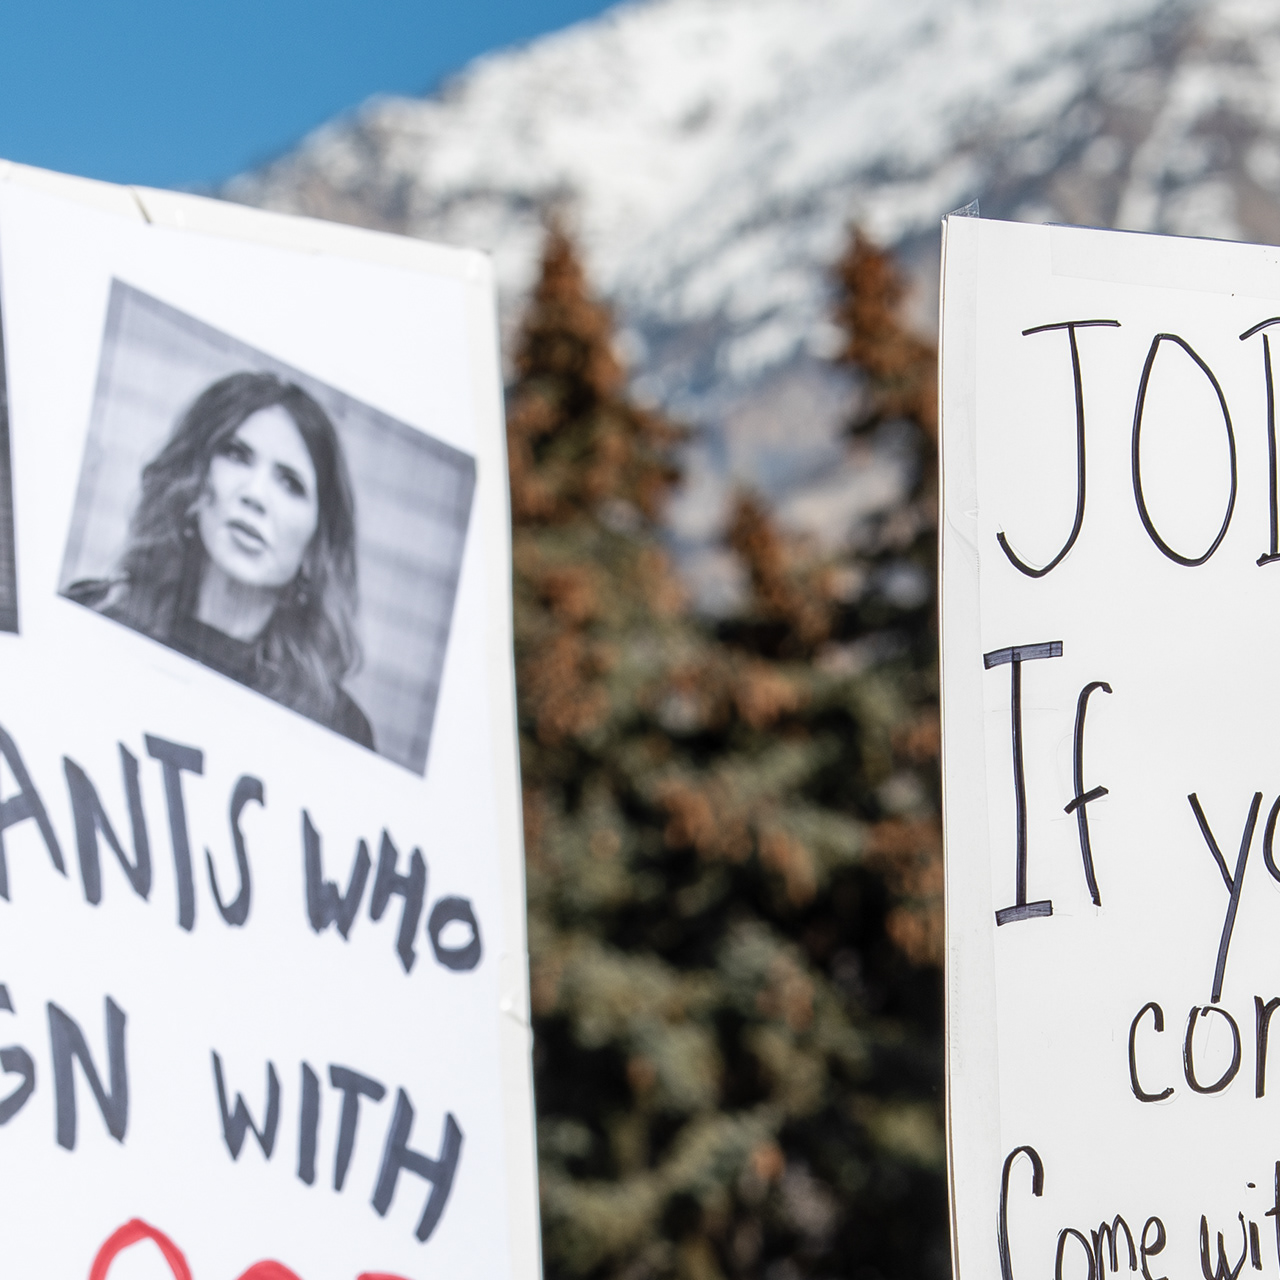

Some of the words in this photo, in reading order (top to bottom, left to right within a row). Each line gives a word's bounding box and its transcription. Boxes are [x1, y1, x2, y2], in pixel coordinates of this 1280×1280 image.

[982, 640, 1113, 925] If
[300, 807, 484, 974] WHO
[211, 1049, 463, 1243] WITH
